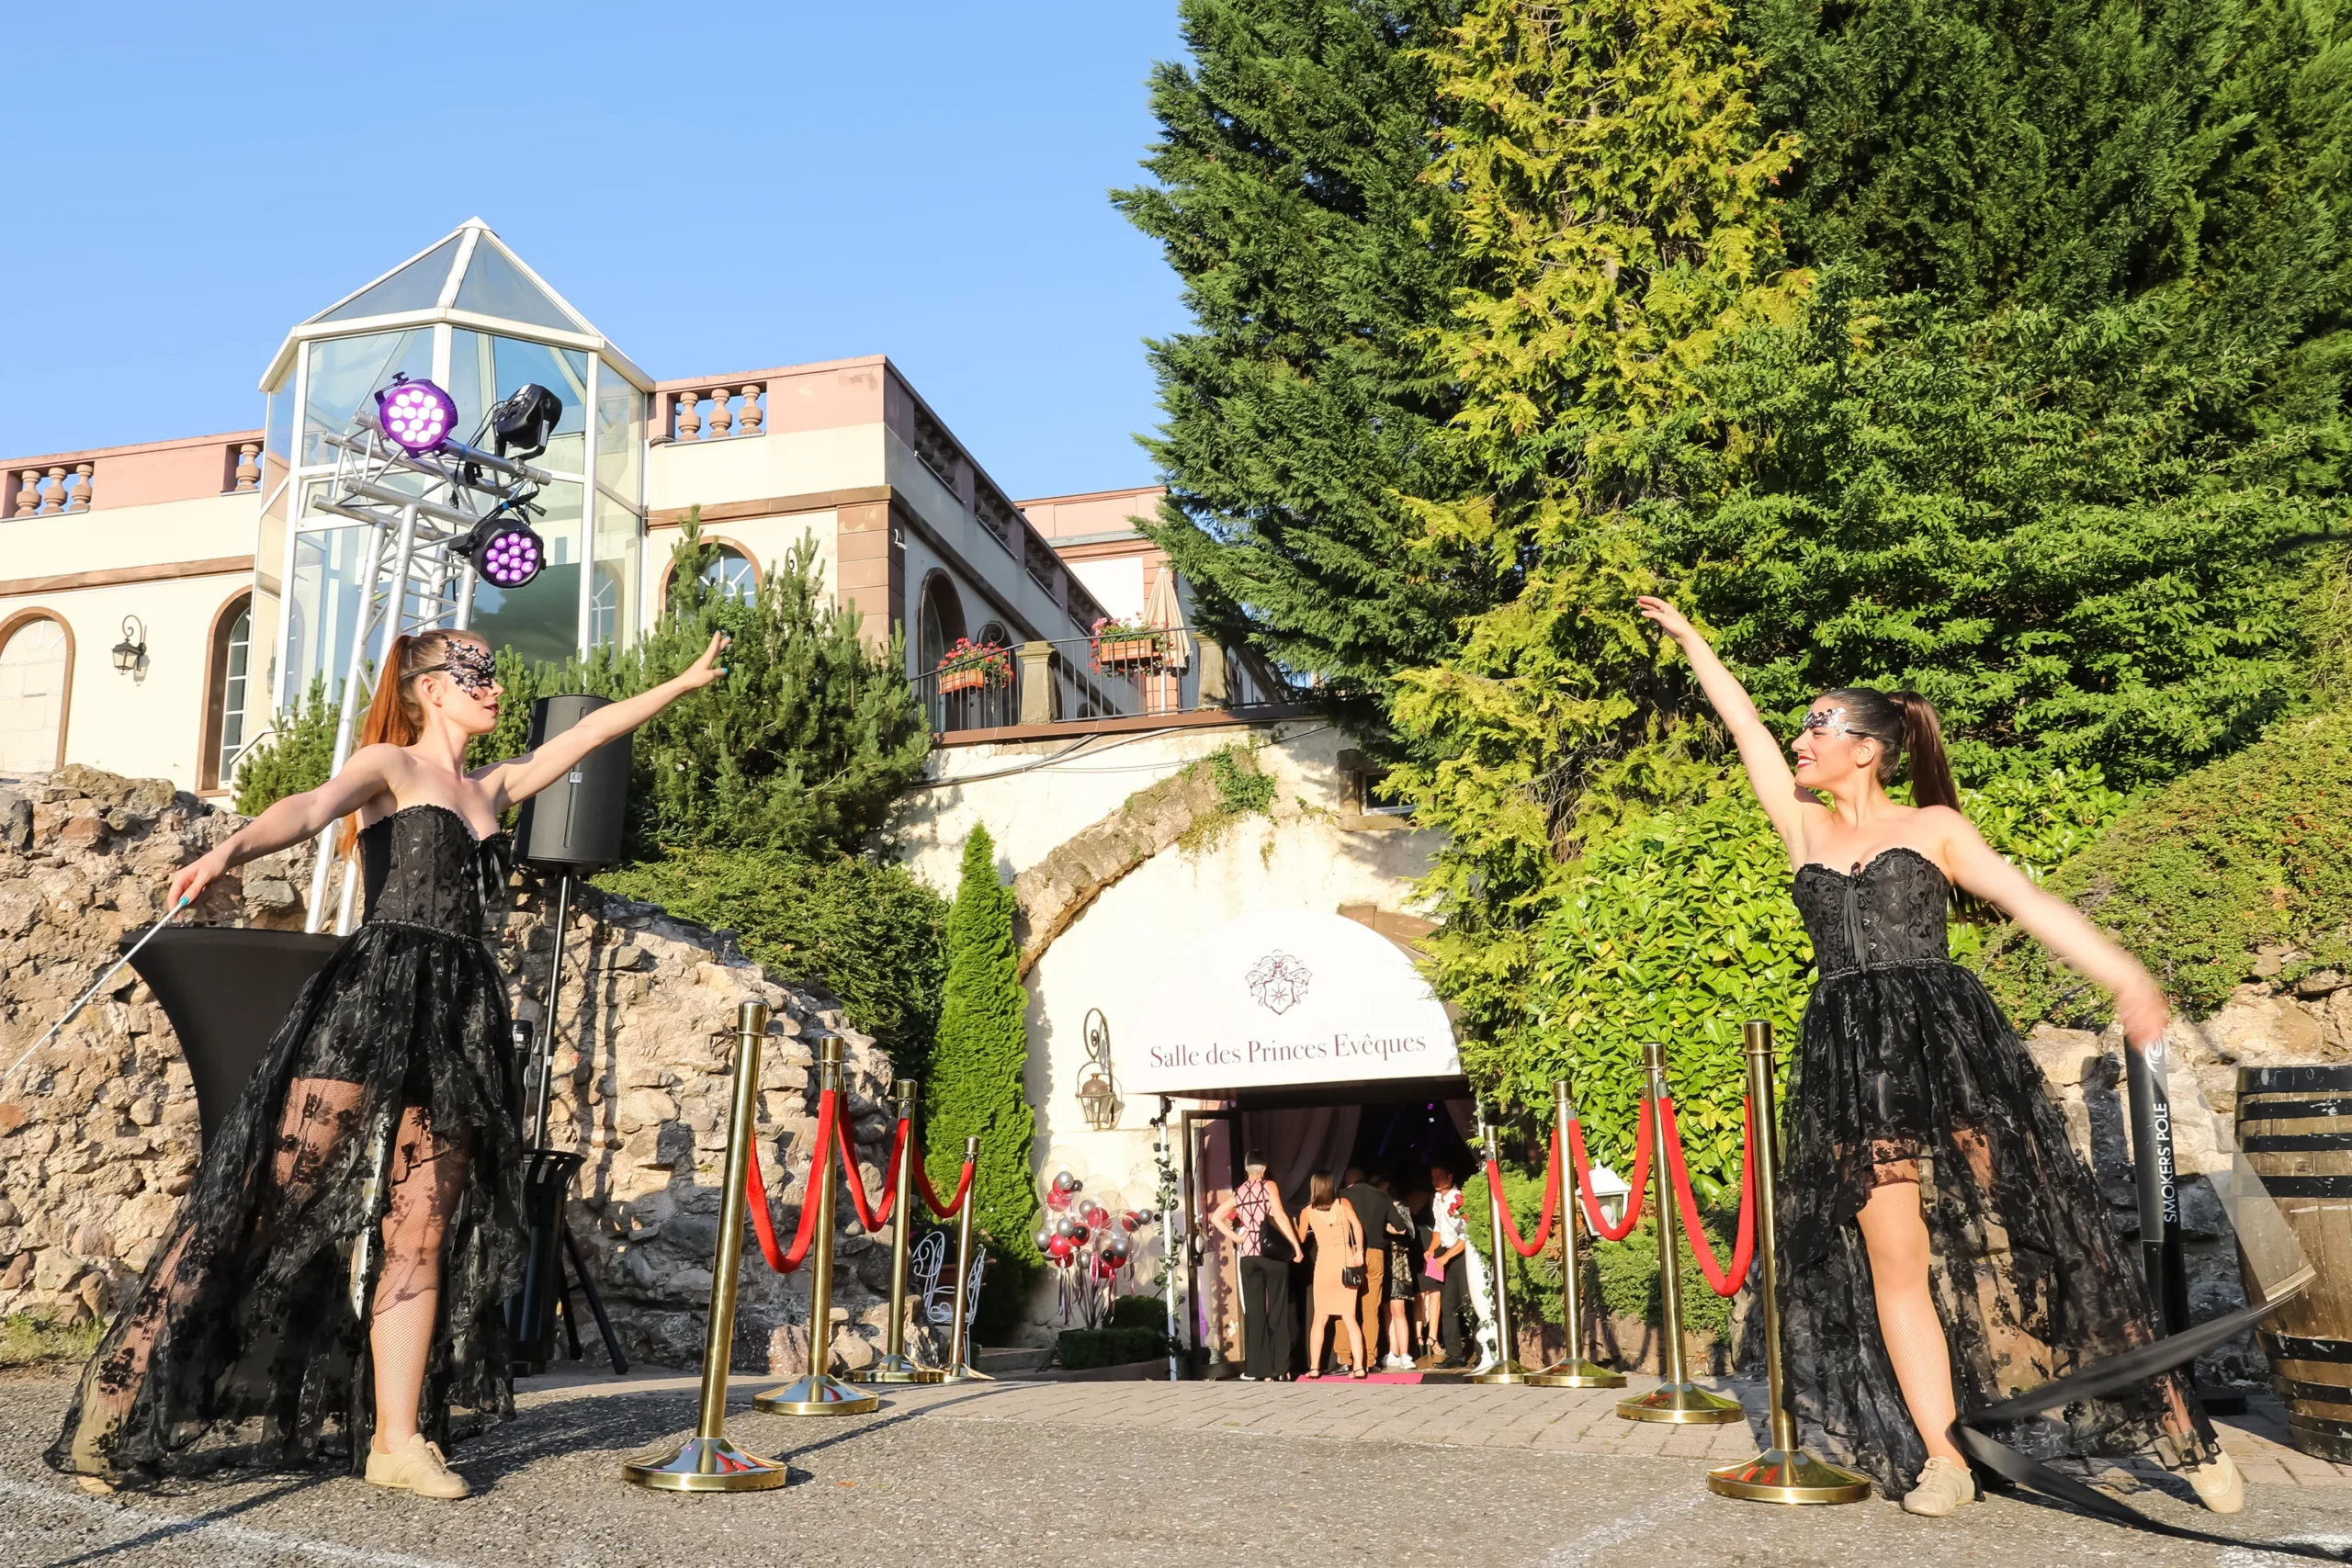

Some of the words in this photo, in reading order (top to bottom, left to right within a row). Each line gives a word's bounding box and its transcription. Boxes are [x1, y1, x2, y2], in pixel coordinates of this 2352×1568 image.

[1149, 1044, 1199, 1067] Salle
[1205, 1042, 1242, 1066] des
[1248, 1039, 1329, 1064] Princes
[1334, 1032, 1428, 1062] Evêques
[2153, 1102, 2170, 1141] POLE
[2157, 1144, 2177, 1224] SMOKERS'
